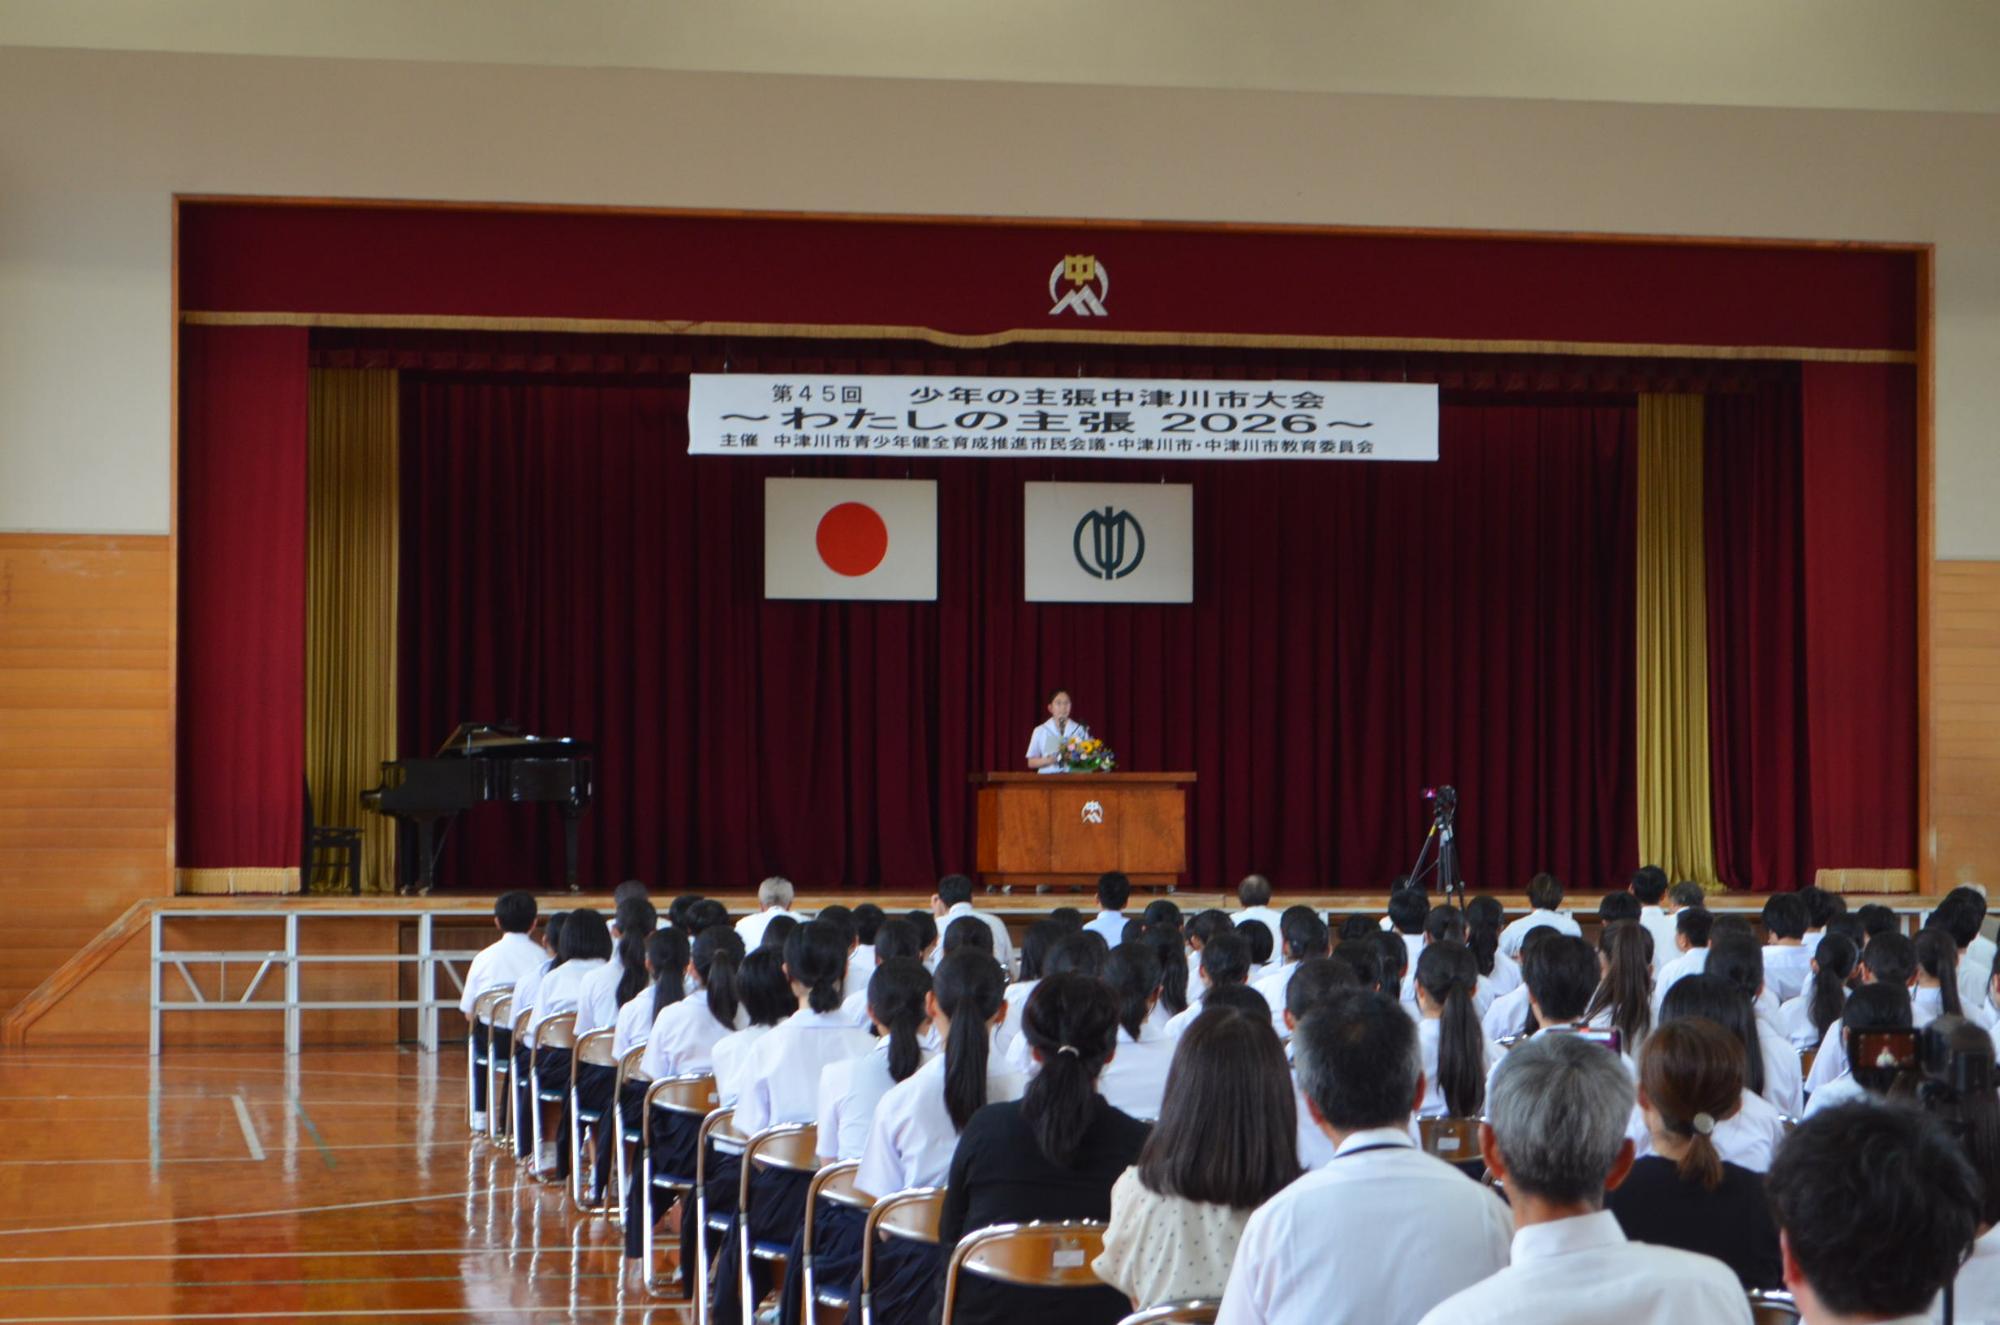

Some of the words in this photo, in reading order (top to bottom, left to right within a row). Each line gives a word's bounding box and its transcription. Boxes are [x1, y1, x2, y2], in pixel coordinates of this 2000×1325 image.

[772, 383, 863, 404] 第45回
[909, 386, 1325, 410] 少年の主張中津川市大会
[719, 433, 759, 448] 主催
